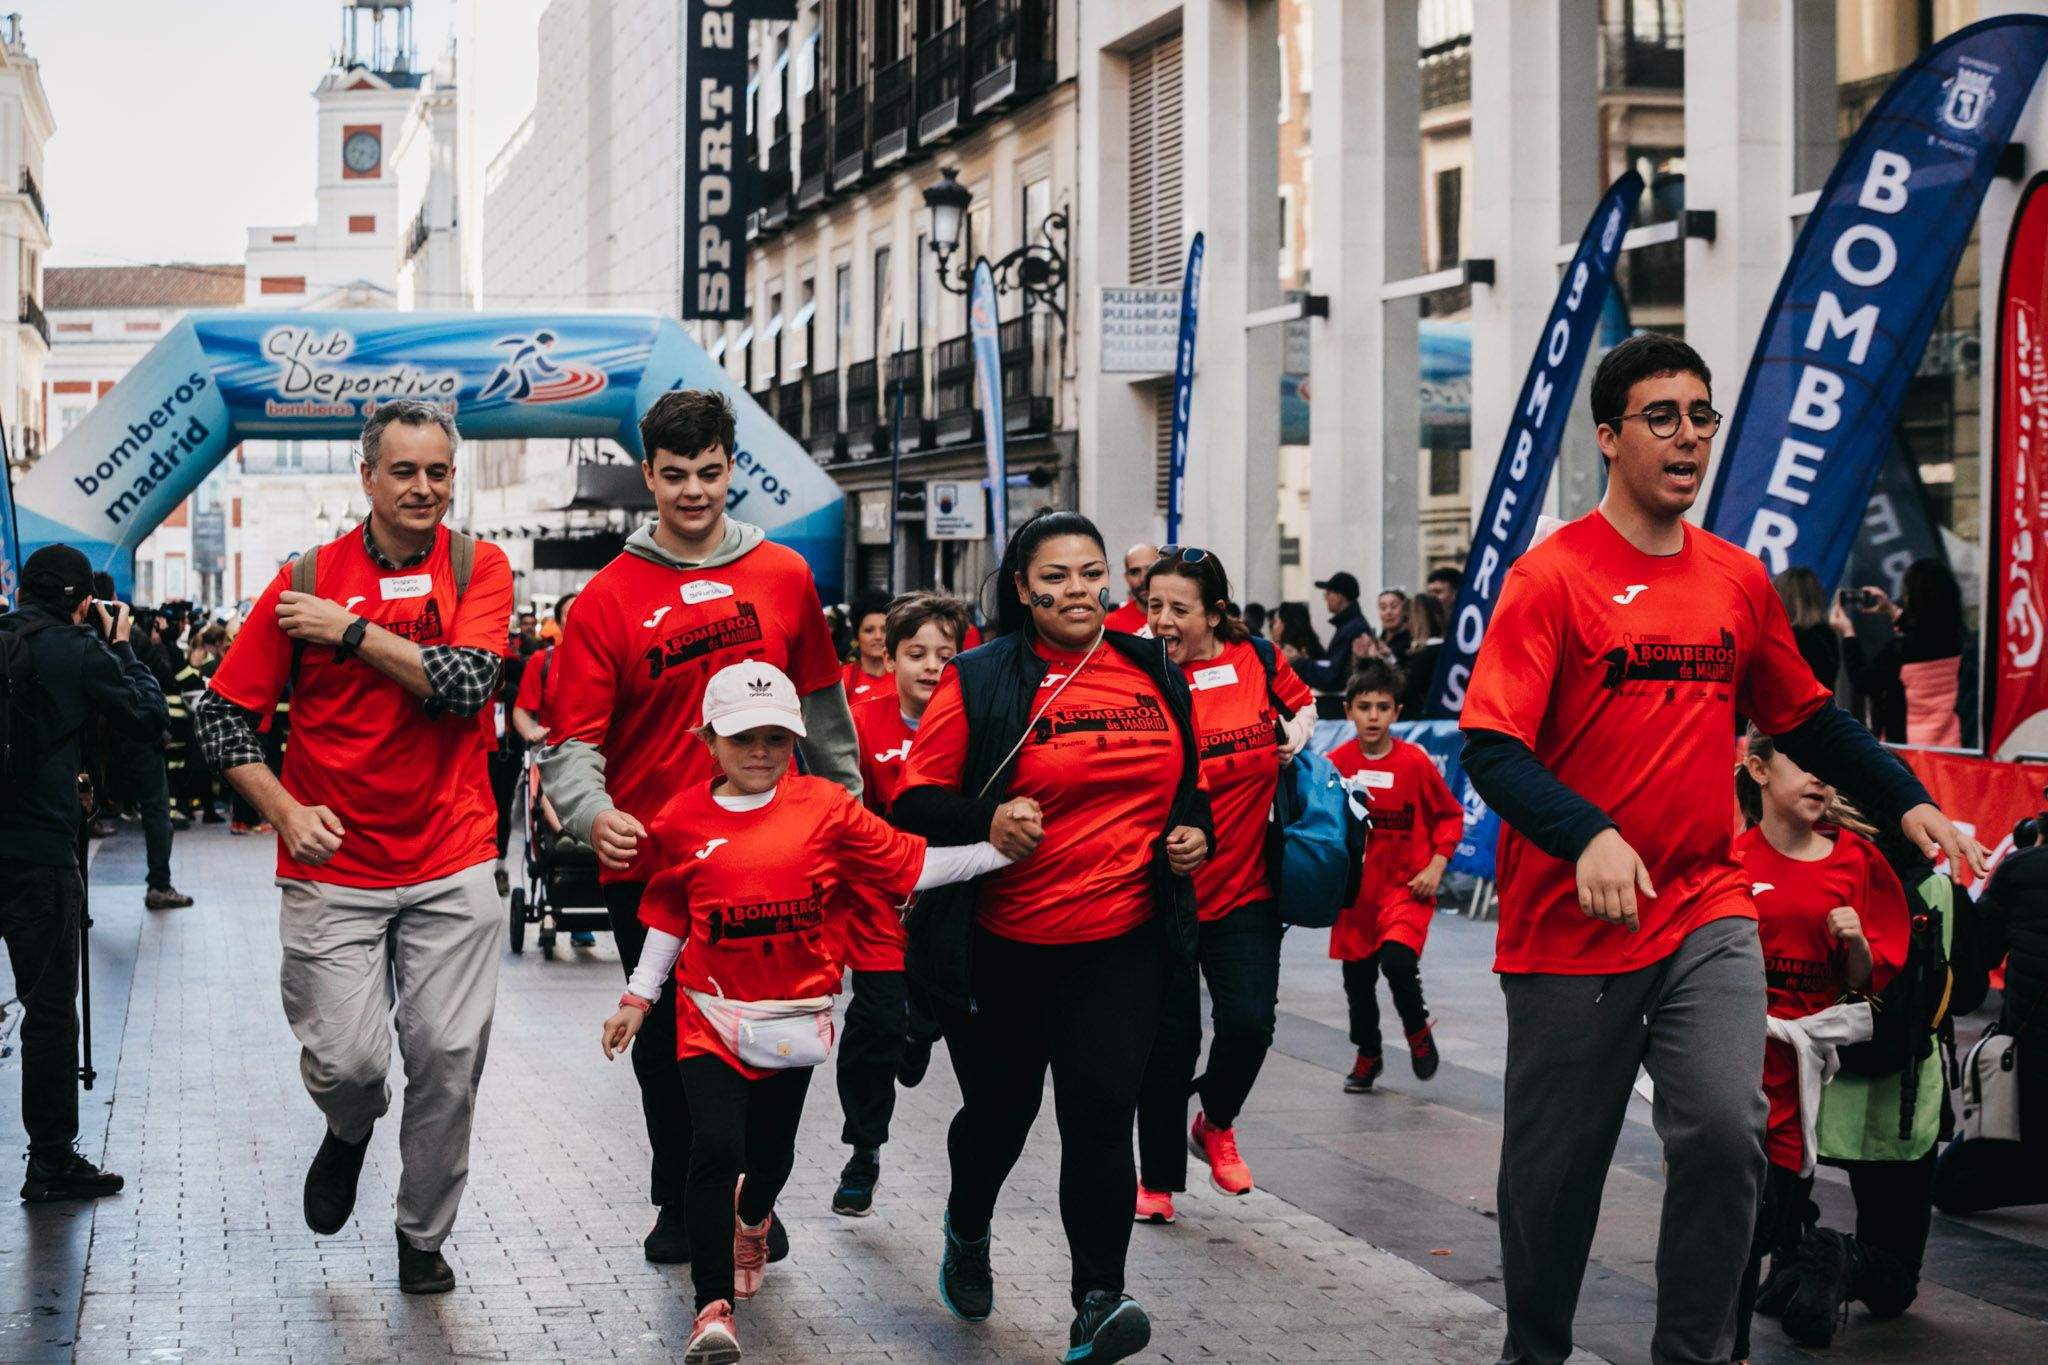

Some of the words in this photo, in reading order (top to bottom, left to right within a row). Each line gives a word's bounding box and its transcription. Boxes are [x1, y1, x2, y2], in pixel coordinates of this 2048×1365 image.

[701, 0, 734, 49] 2
[697, 77, 733, 312] SPORT
[268, 329, 348, 357] Club
[284, 357, 456, 401] Deportivo
[267, 400, 354, 416] bomberos
[74, 372, 207, 496] bomberos
[104, 415, 210, 524] madrid
[1441, 261, 1589, 713] BOMBEROS
[670, 614, 756, 650] BOMBEROS
[720, 626, 760, 645] MADRID
[1640, 645, 1734, 664] BOMBEROS
[1679, 662, 1694, 679] de
[1064, 706, 1160, 721] BOMBEROS
[1105, 719, 1121, 731] de
[1123, 717, 1167, 731] MADRID
